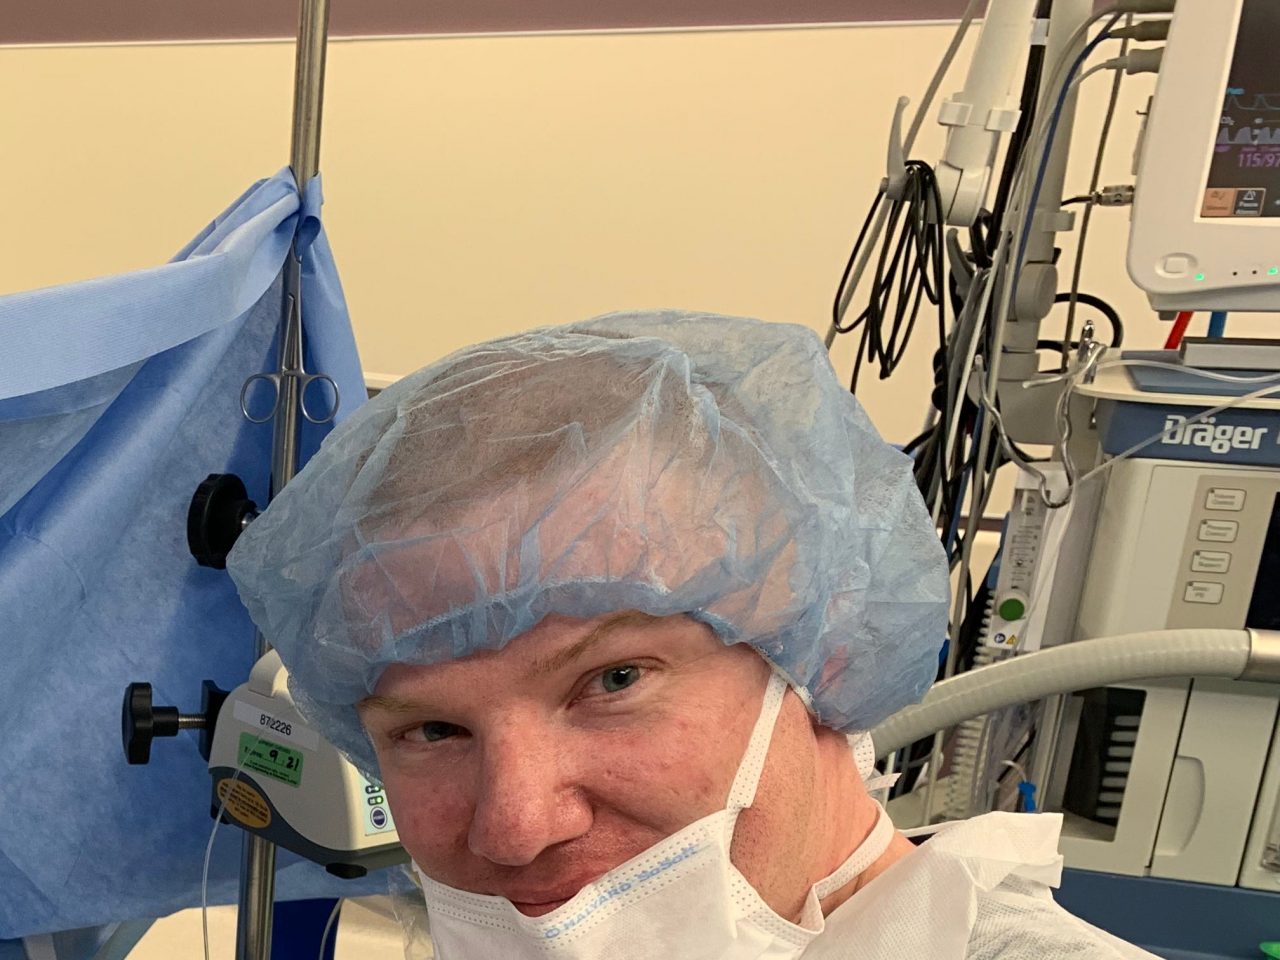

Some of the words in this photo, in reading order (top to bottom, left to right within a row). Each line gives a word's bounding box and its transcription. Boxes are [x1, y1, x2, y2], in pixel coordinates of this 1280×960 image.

[1161, 414, 1269, 454] Dräger
[269, 749, 279, 763] 9
[286, 756, 300, 771] 21
